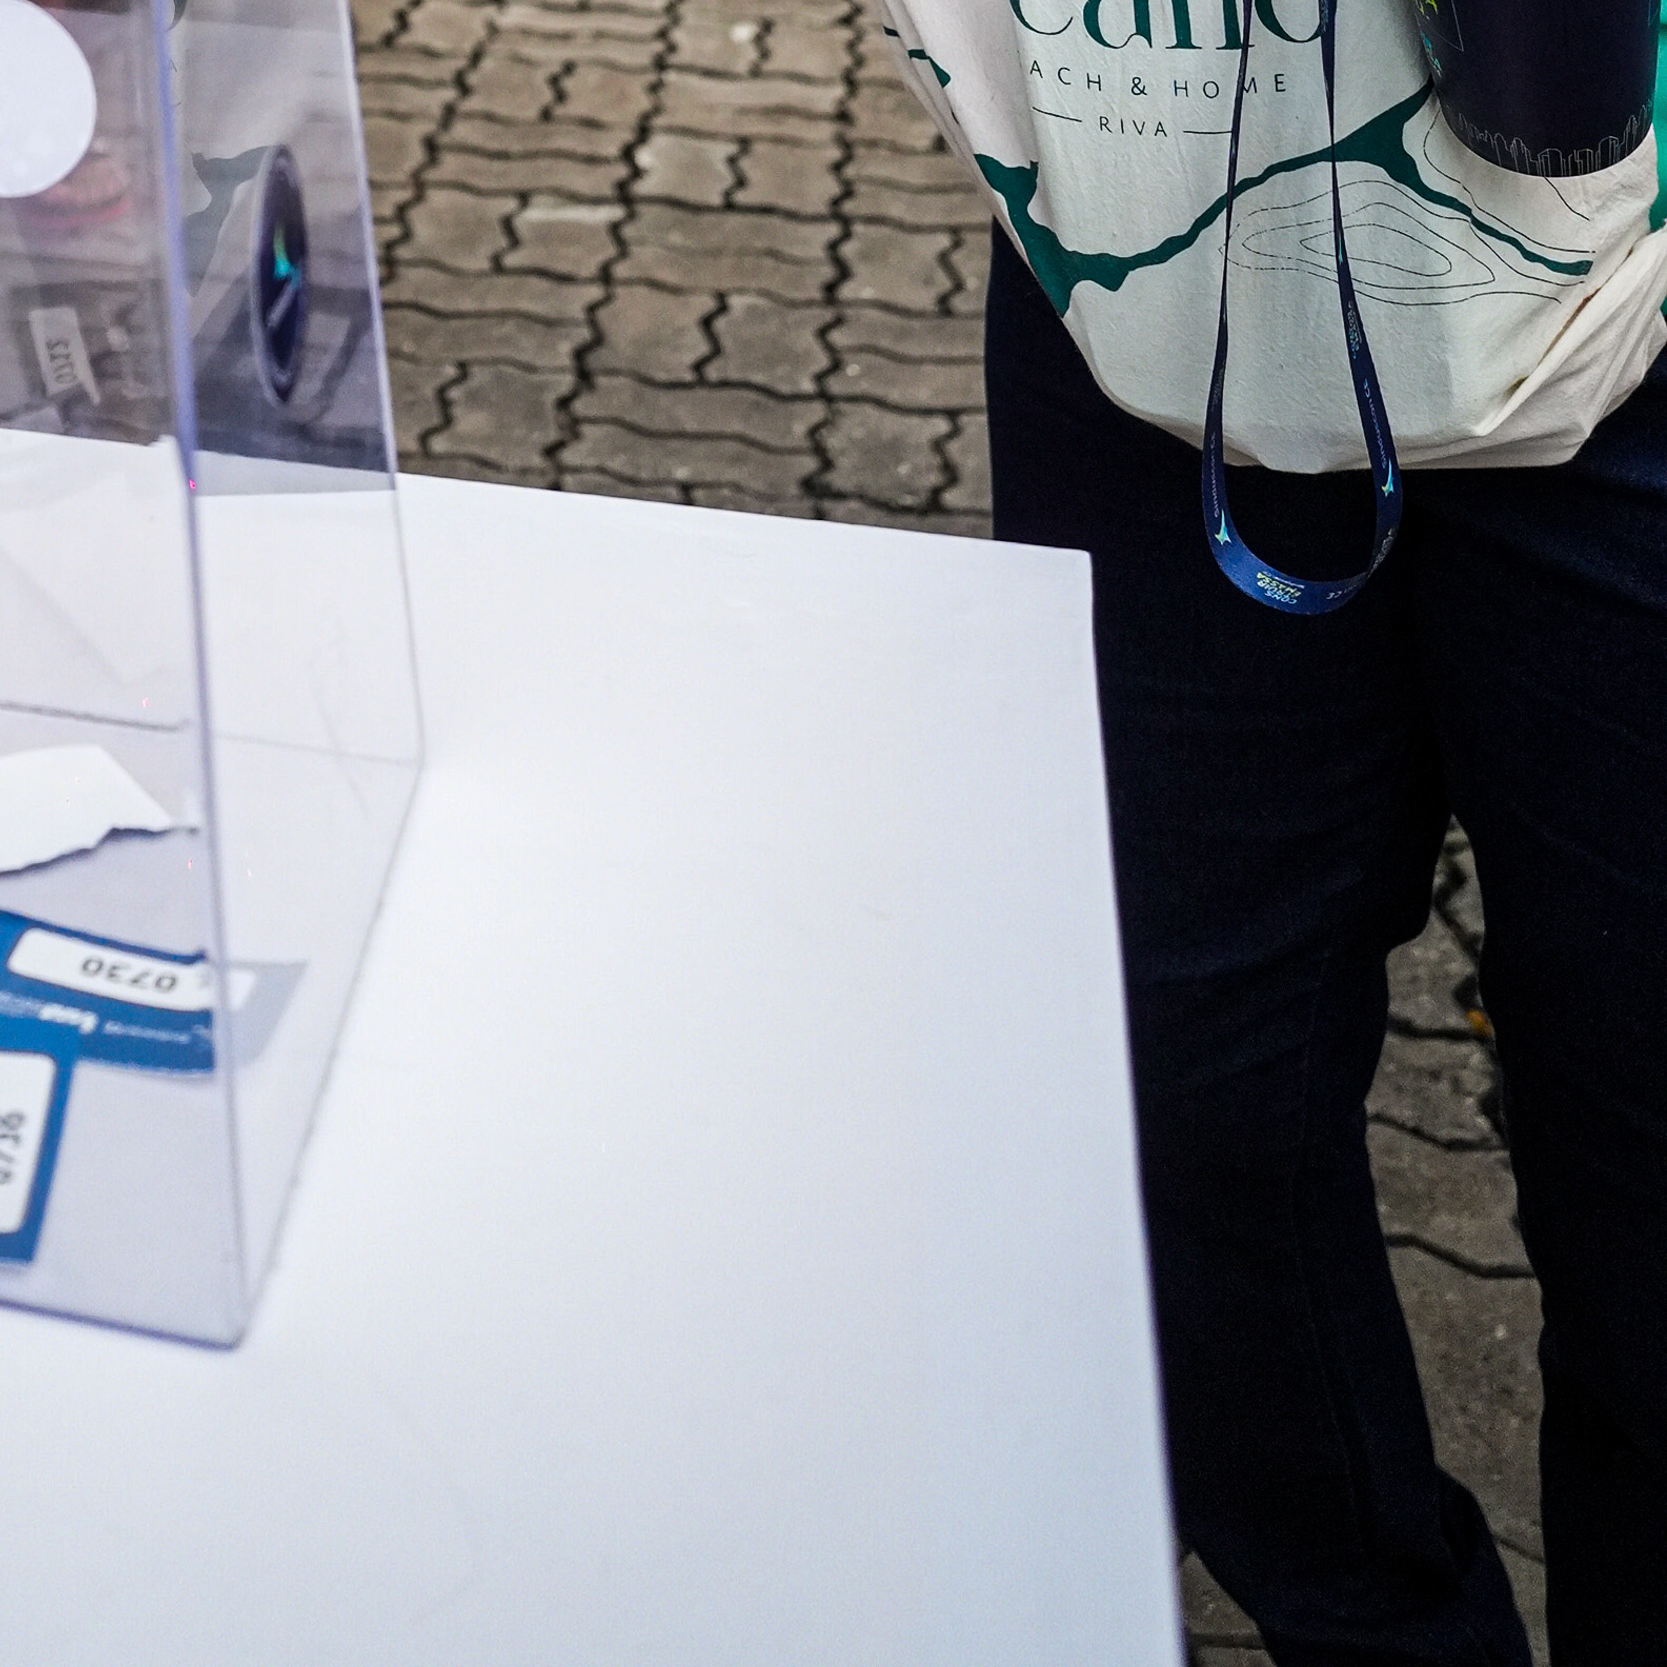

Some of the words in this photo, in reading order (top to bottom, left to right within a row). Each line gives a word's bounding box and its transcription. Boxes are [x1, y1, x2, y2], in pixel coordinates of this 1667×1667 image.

[1029, 59, 1102, 92] ACH
[1131, 76, 1148, 96] &
[1173, 72, 1288, 99] HOME
[1099, 115, 1169, 138] RIVA
